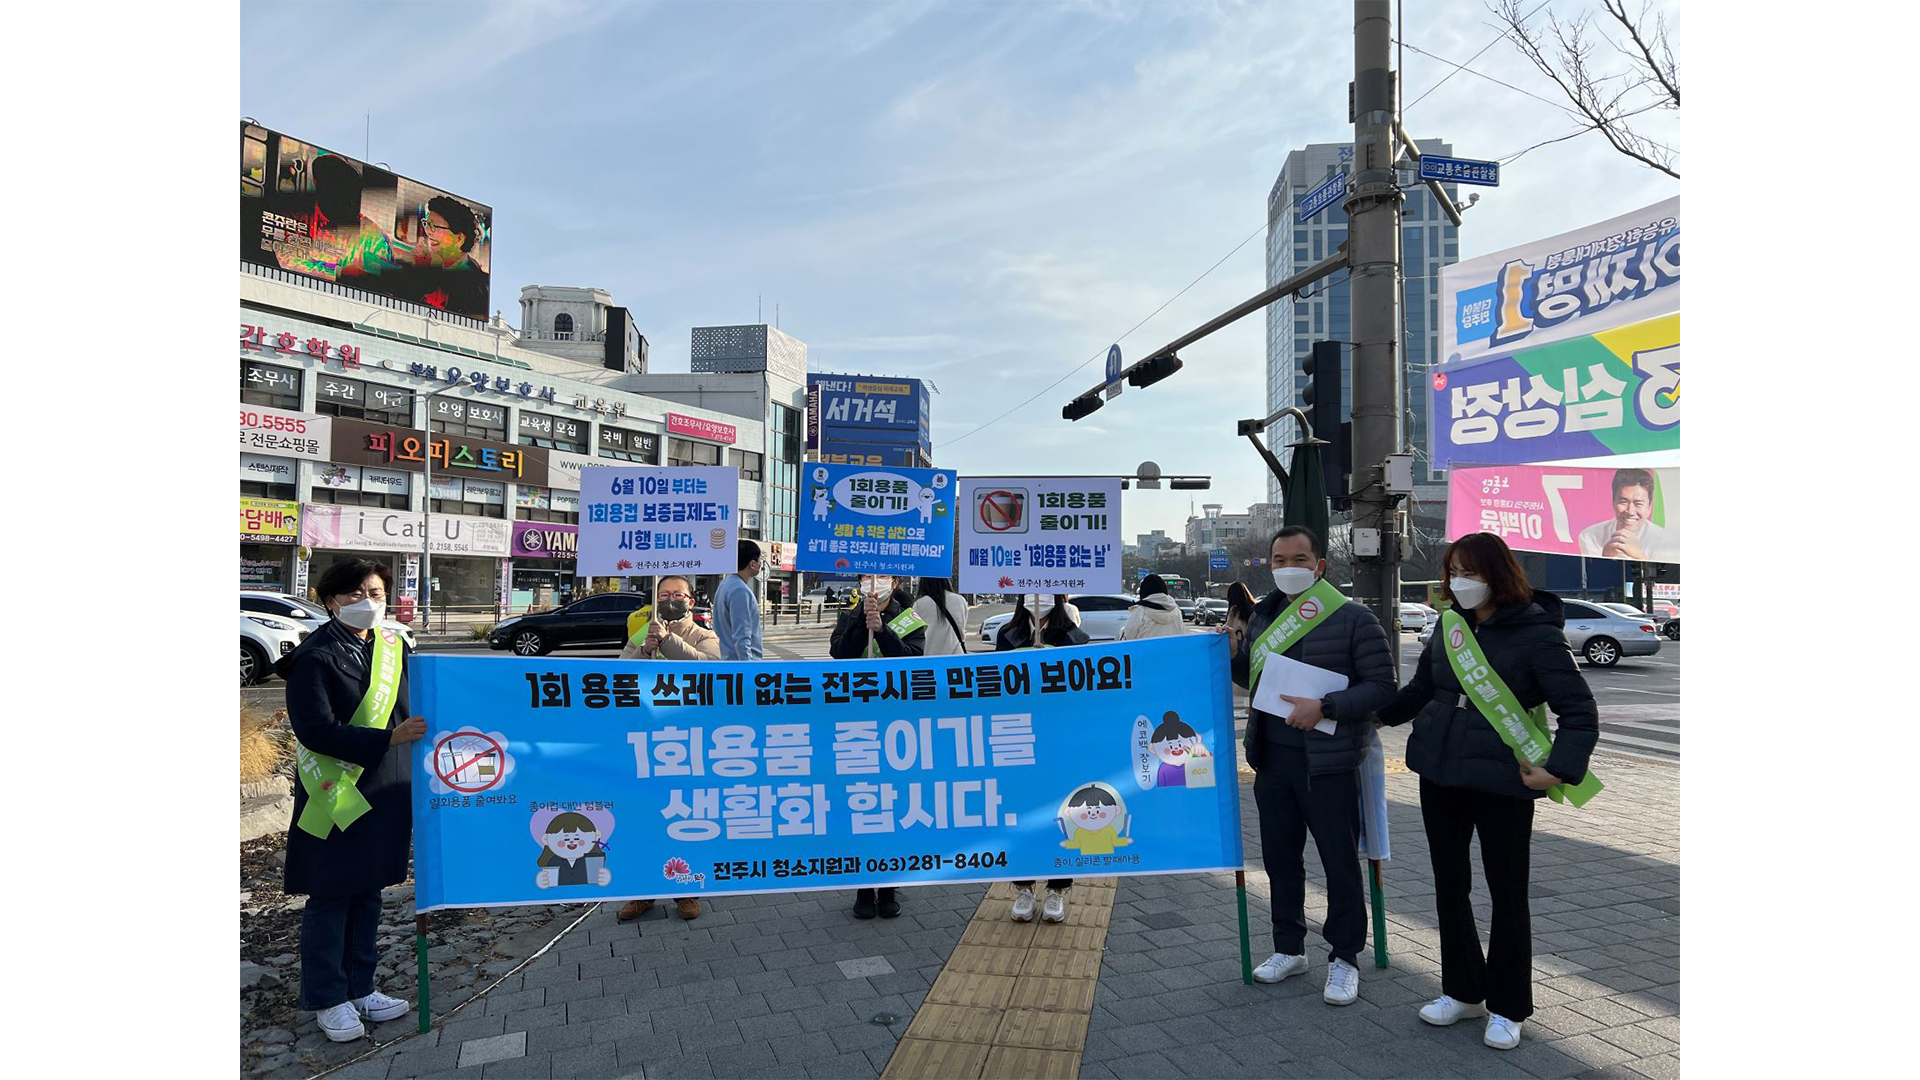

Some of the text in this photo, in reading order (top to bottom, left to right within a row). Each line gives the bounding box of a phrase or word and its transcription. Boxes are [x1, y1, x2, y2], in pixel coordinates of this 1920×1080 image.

[240, 324, 628, 418] 간호학원 부설 요양보호사 교육원
[248, 369, 296, 390] 조무사
[324, 381, 356, 400] 주간
[808, 390, 818, 427] YAMAHA
[826, 397, 897, 423] 서거석
[437, 401, 653, 449] 요양 보호사 교육생 모집 국비 일반
[251, 432, 320, 455] 전문쇼핑몰
[369, 431, 523, 478] 피오피스토리
[611, 476, 707, 496] 6월 10일 부터는
[849, 478, 909, 495] 1회용품
[850, 495, 909, 511] 줄이기!
[1037, 492, 1107, 509] 1회용품
[587, 502, 638, 523] 1회용컵
[643, 502, 729, 523] 보증금제도가
[1040, 514, 1108, 531] 줄이기!
[358, 511, 366, 535] i
[382, 514, 425, 538] Cat
[445, 519, 460, 540] U
[856, 524, 866, 537] 속
[867, 525, 886, 539] 작은
[888, 526, 926, 541] 실천으로
[618, 530, 697, 551] 시행 됩니다.
[808, 538, 827, 552] 살기
[829, 540, 848, 553] 좋은
[850, 541, 878, 554] 전주시
[880, 542, 900, 556] 함께
[635, 559, 702, 570] 전주시 청소지원과
[853, 561, 915, 571] 전주시 청소지원과
[969, 548, 988, 567] 매월
[990, 545, 1022, 567] 10일은
[1069, 544, 1091, 568] 없는
[1017, 578, 1086, 588] 전주시 청소지원과
[1456, 649, 1478, 672] 매월
[525, 654, 1132, 709] 1회 용품 쓰레기 없는 전주시를 만들어 보아요!
[626, 712, 1036, 779] 1회용품 줄이기를
[429, 793, 518, 811] 일회용품 줄여봐요
[528, 801, 559, 812] 종이컵
[584, 800, 614, 812] 텀블러
[660, 777, 1017, 842] 생활화 합시다.
[713, 860, 767, 881] 전주시
[772, 856, 862, 878] 청소지원과
[1076, 856, 1101, 867] 실리콘
